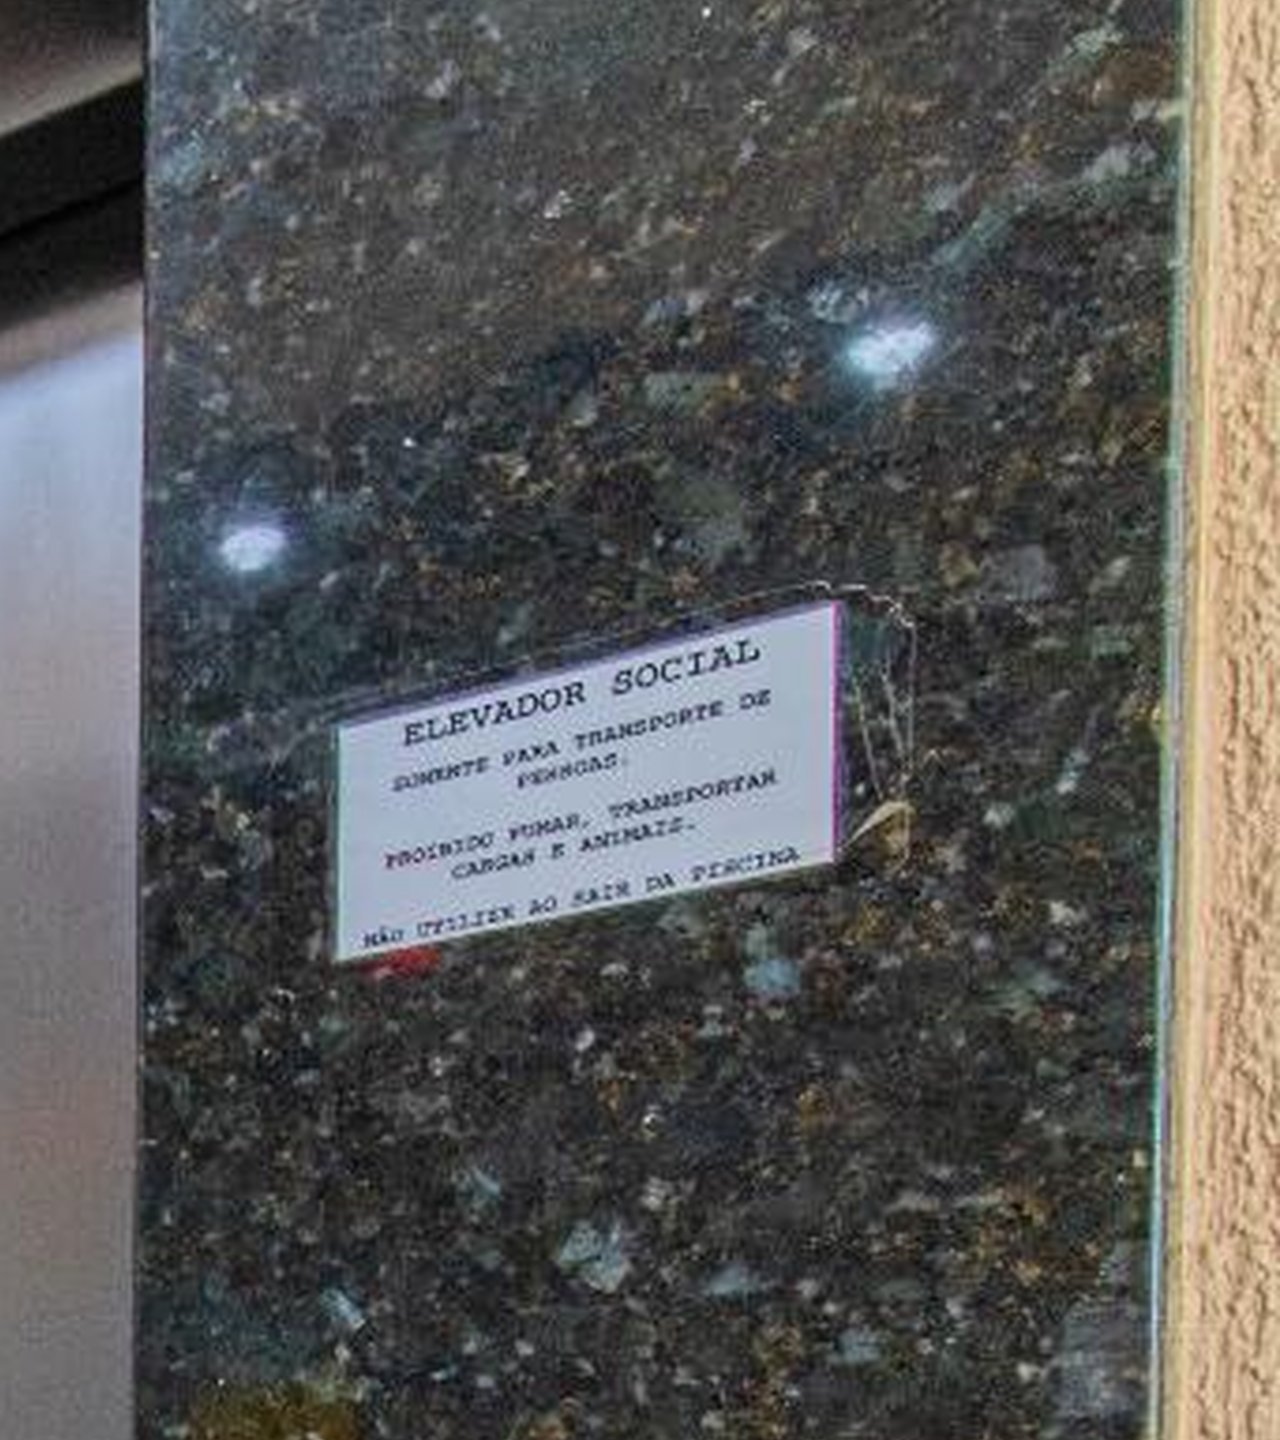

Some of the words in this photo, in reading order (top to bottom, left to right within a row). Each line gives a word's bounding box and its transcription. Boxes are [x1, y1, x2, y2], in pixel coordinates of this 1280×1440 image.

[403, 680, 587, 747] ELEVADOR
[612, 639, 761, 695] SOCIAL
[392, 756, 489, 793] SOMENTE
[502, 741, 561, 767] PARA
[574, 700, 725, 750] TRANSPORTE
[739, 688, 773, 711] DE
[607, 766, 779, 820] TRANSPORTAR
[450, 848, 536, 880] CARGAS
[550, 842, 566, 860] E
[527, 895, 558, 917] AO
[645, 871, 676, 894] DA
